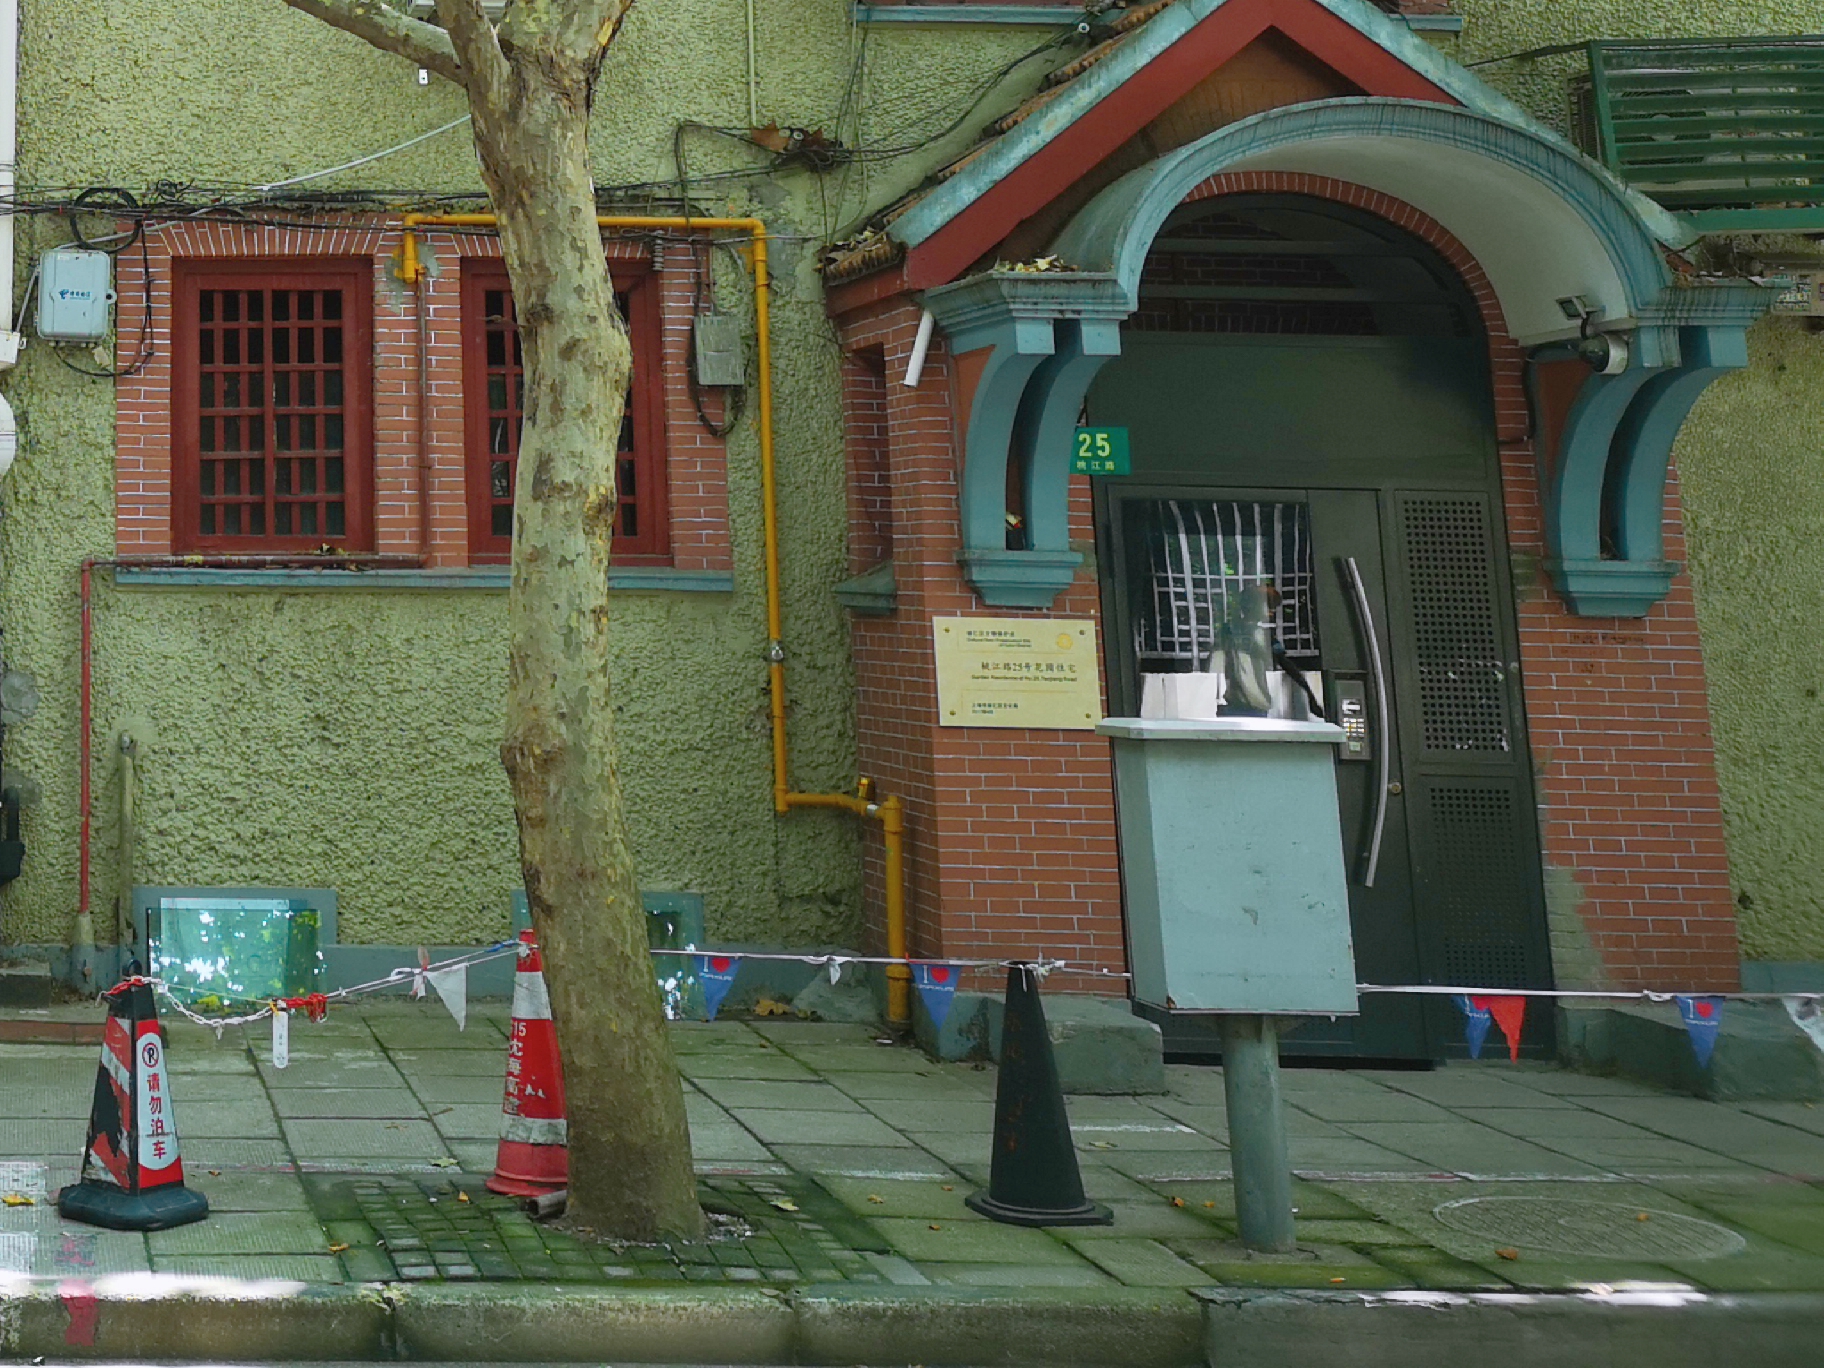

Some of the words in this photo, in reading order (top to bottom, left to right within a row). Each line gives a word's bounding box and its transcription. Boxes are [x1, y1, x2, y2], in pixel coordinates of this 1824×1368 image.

[1078, 433, 1111, 457] 25
[146, 1072, 167, 1160] 请勿泊车
